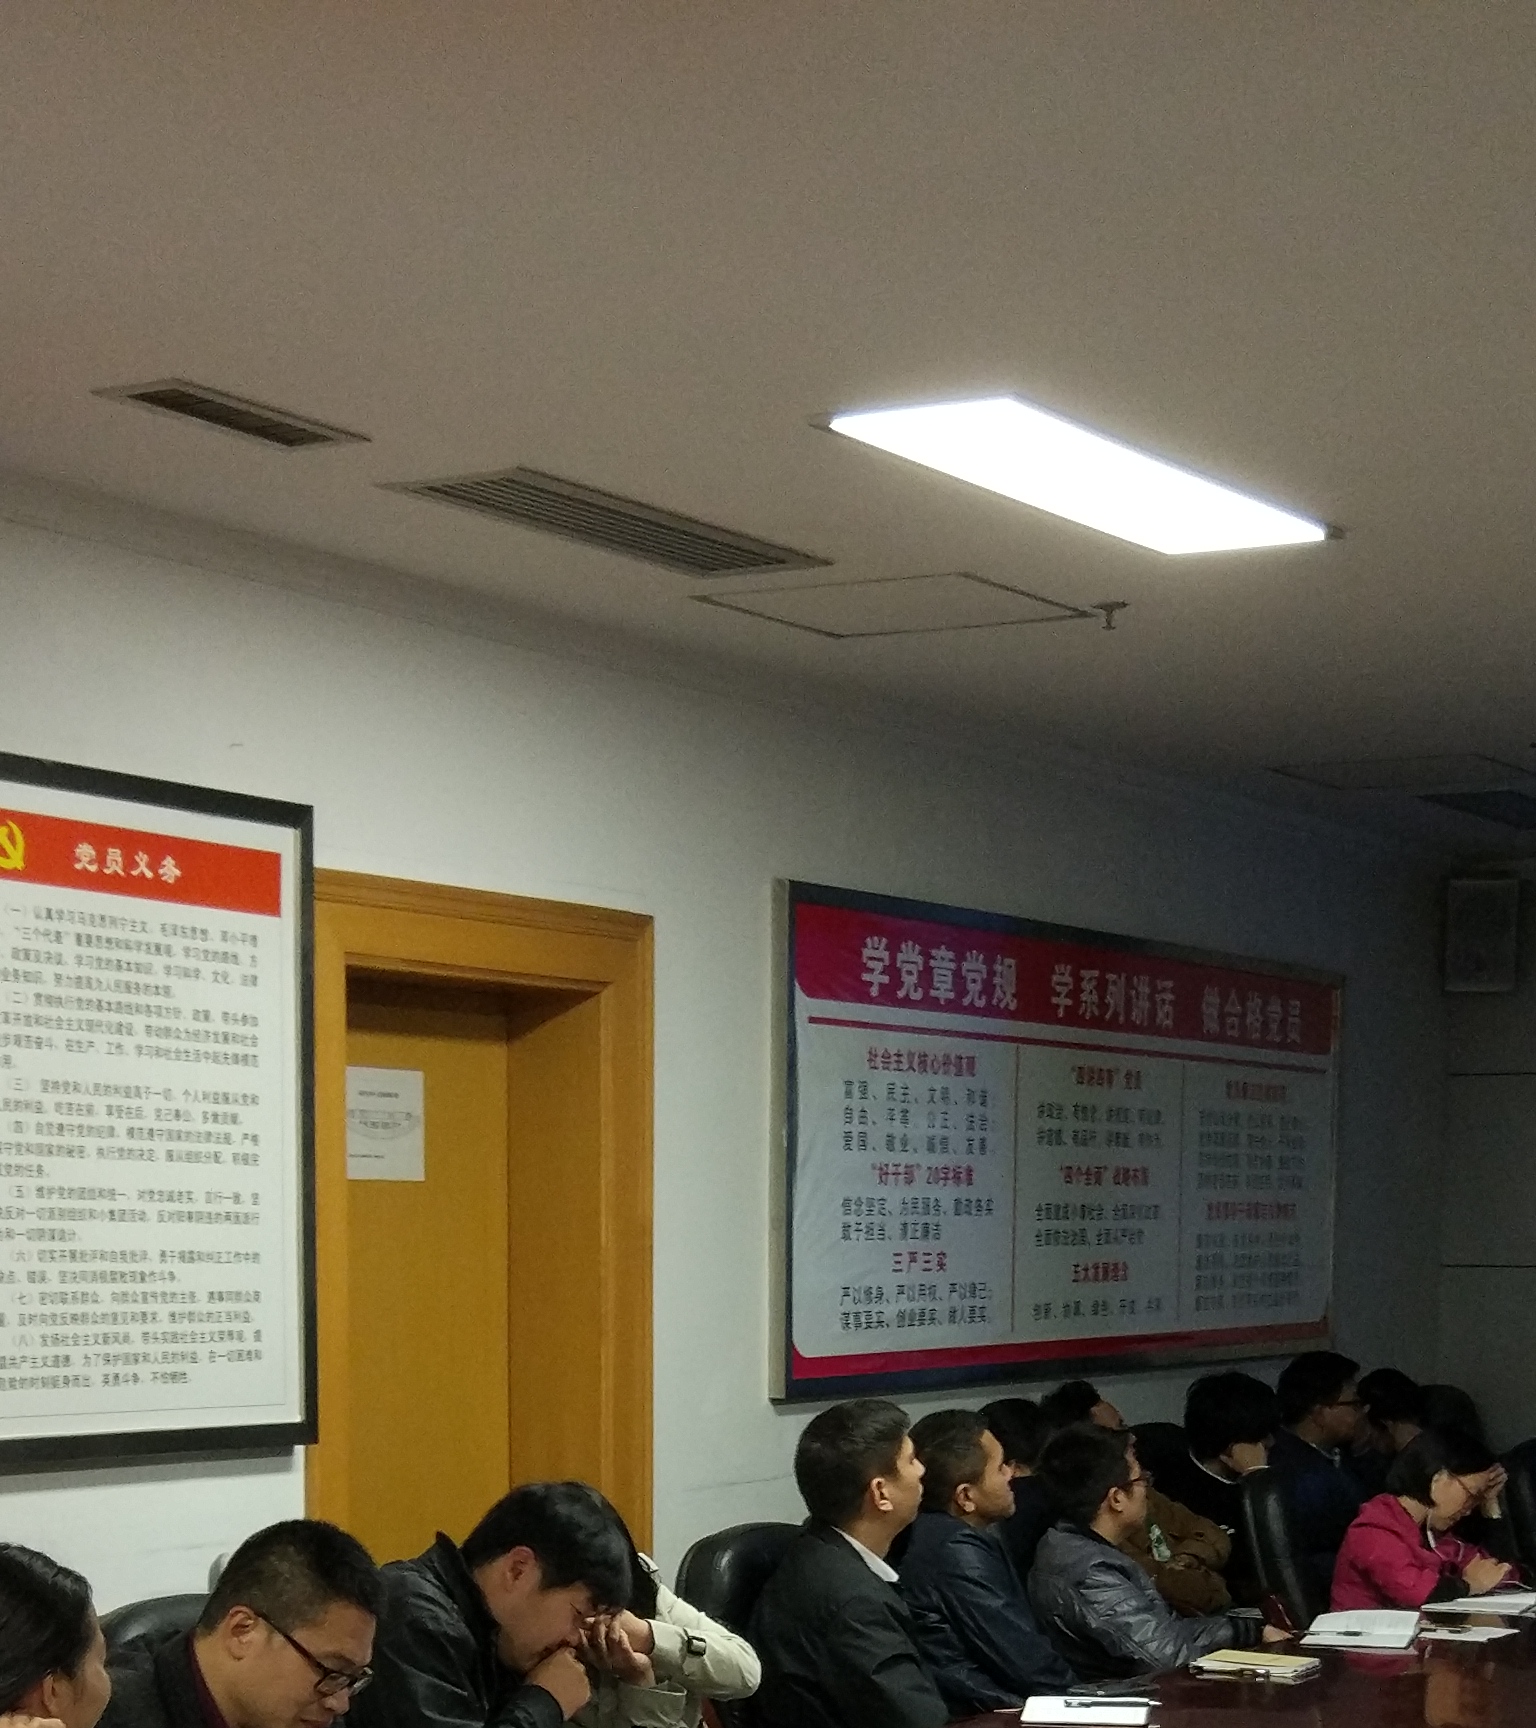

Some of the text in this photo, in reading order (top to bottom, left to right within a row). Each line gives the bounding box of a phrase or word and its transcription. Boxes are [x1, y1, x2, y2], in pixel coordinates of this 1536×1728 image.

[74, 842, 183, 885] 党员义务
[862, 935, 1018, 1012] 学党章党规
[1051, 964, 1176, 1028] 学系列讲话
[892, 1251, 948, 1273] 三严三实
